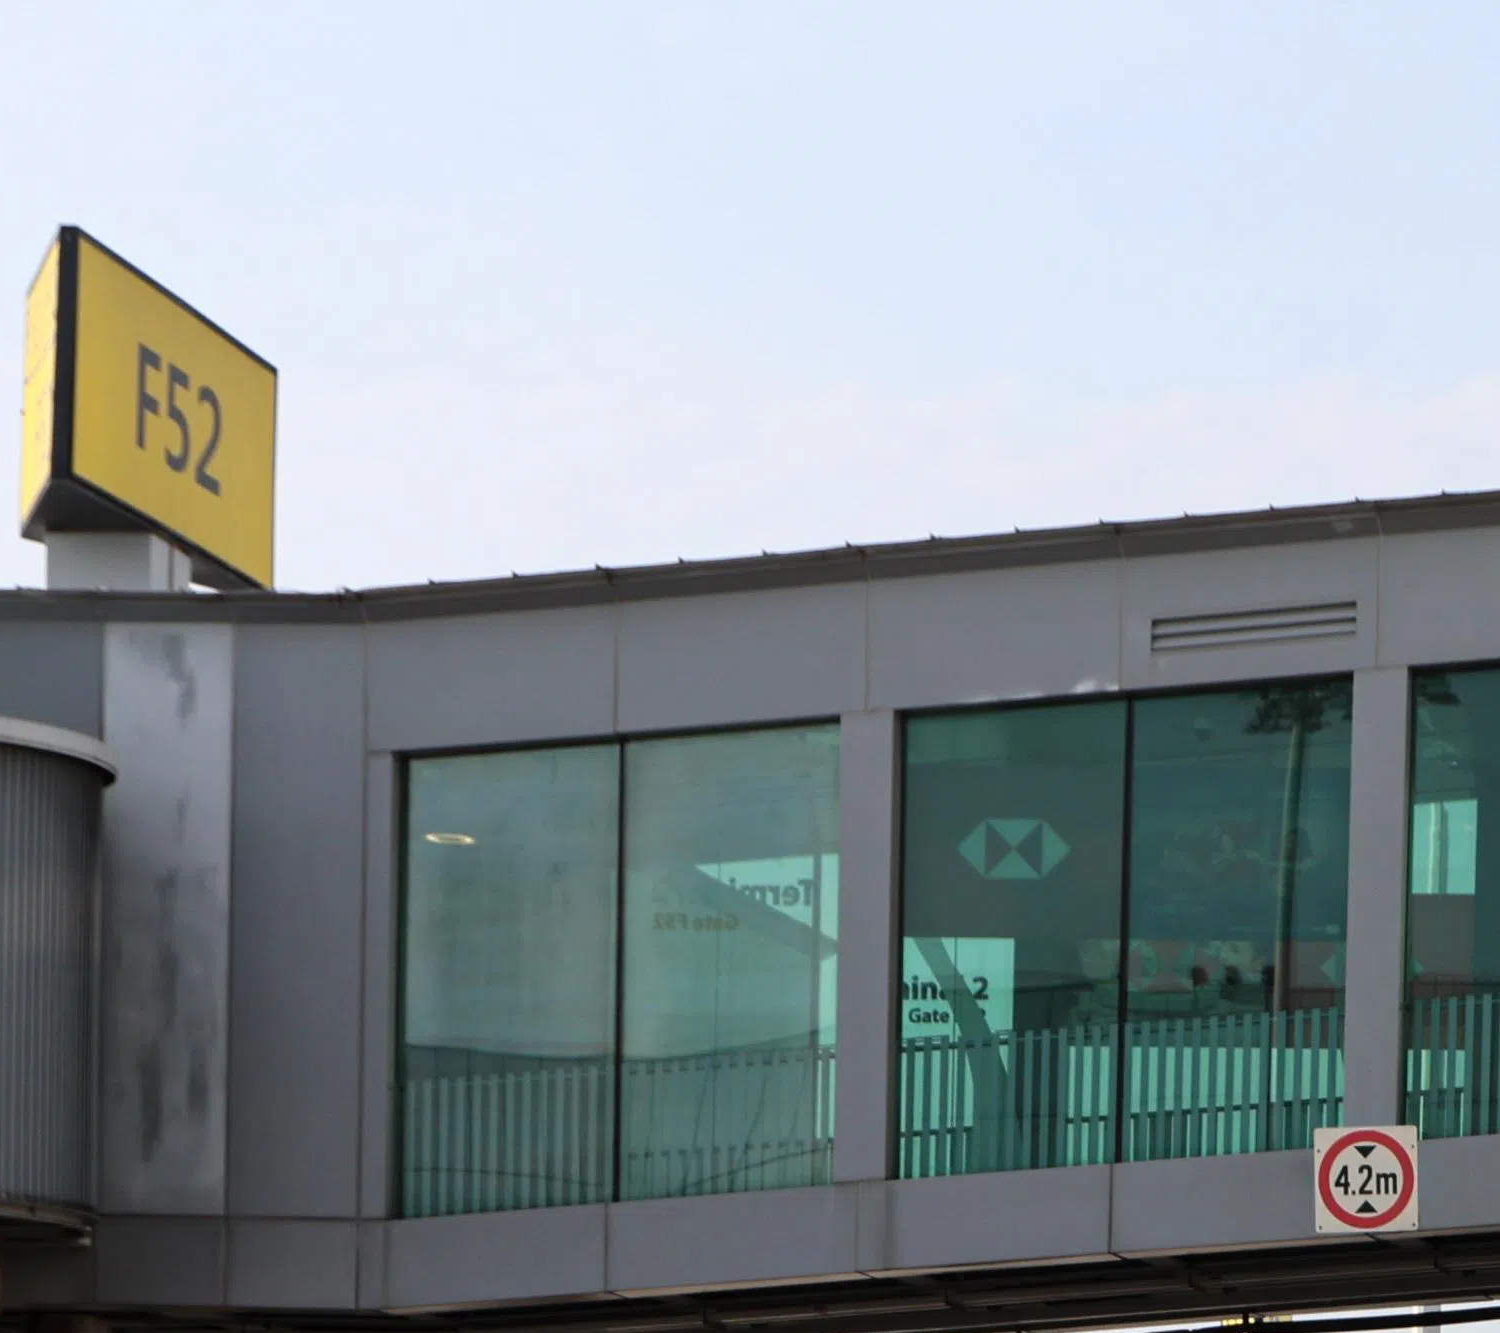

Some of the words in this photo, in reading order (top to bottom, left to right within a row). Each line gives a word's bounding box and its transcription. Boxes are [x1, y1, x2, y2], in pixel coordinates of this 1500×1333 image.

[136, 341, 221, 496] F52
[908, 1007, 950, 1023] Gate
[1334, 1164, 1398, 1196] 4.2m
